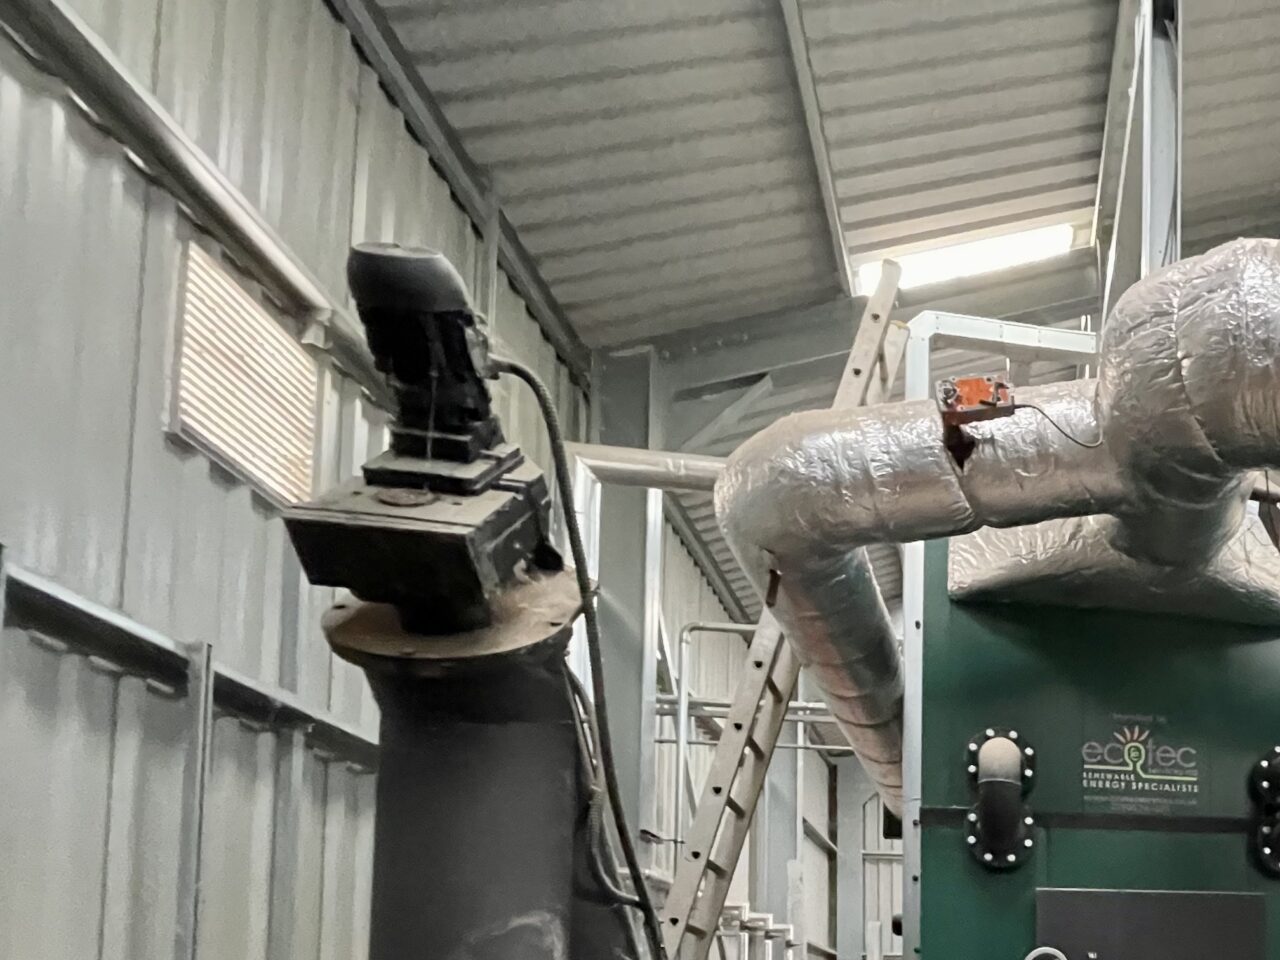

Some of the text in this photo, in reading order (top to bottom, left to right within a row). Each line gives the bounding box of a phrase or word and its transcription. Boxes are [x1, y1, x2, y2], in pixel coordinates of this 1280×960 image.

[1082, 771, 1136, 781] RENEWABLE
[1082, 779, 1199, 793] ENERGY SPECIALISTS
